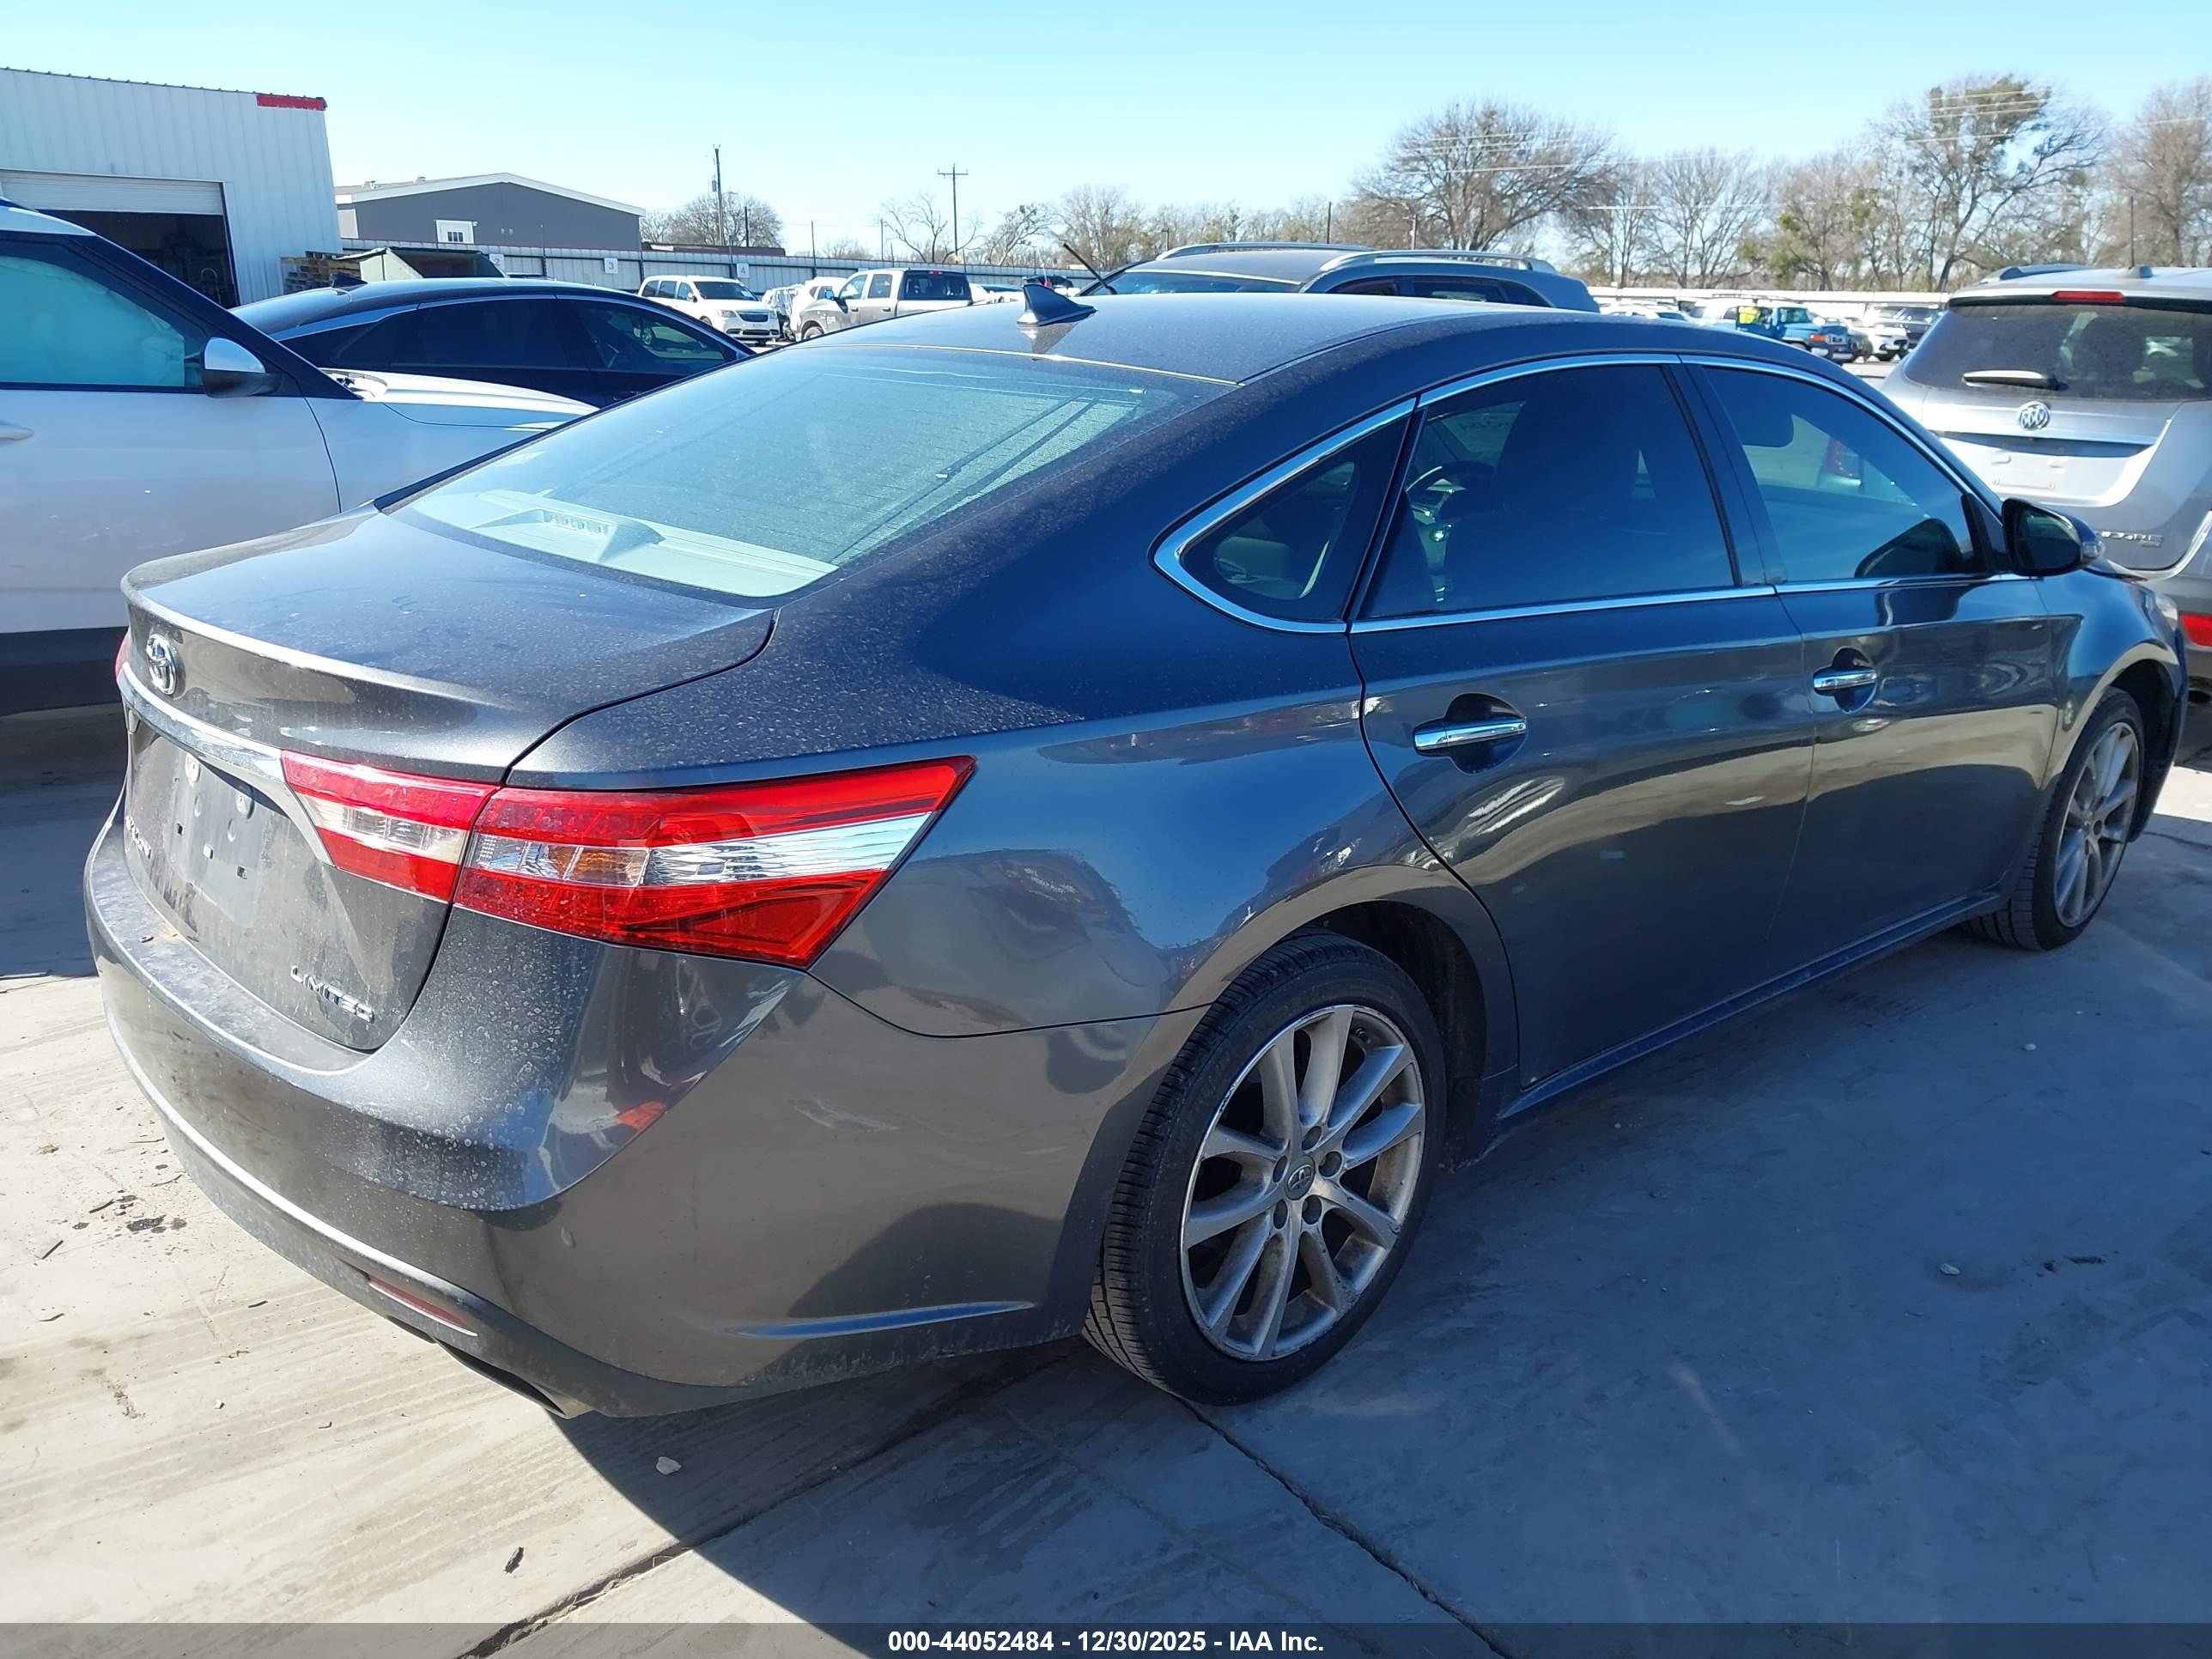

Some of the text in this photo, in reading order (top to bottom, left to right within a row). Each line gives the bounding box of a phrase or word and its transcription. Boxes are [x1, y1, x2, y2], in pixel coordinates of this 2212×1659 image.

[494, 258, 501, 266] 2
[608, 261, 615, 270] 3
[740, 266, 746, 275] 4
